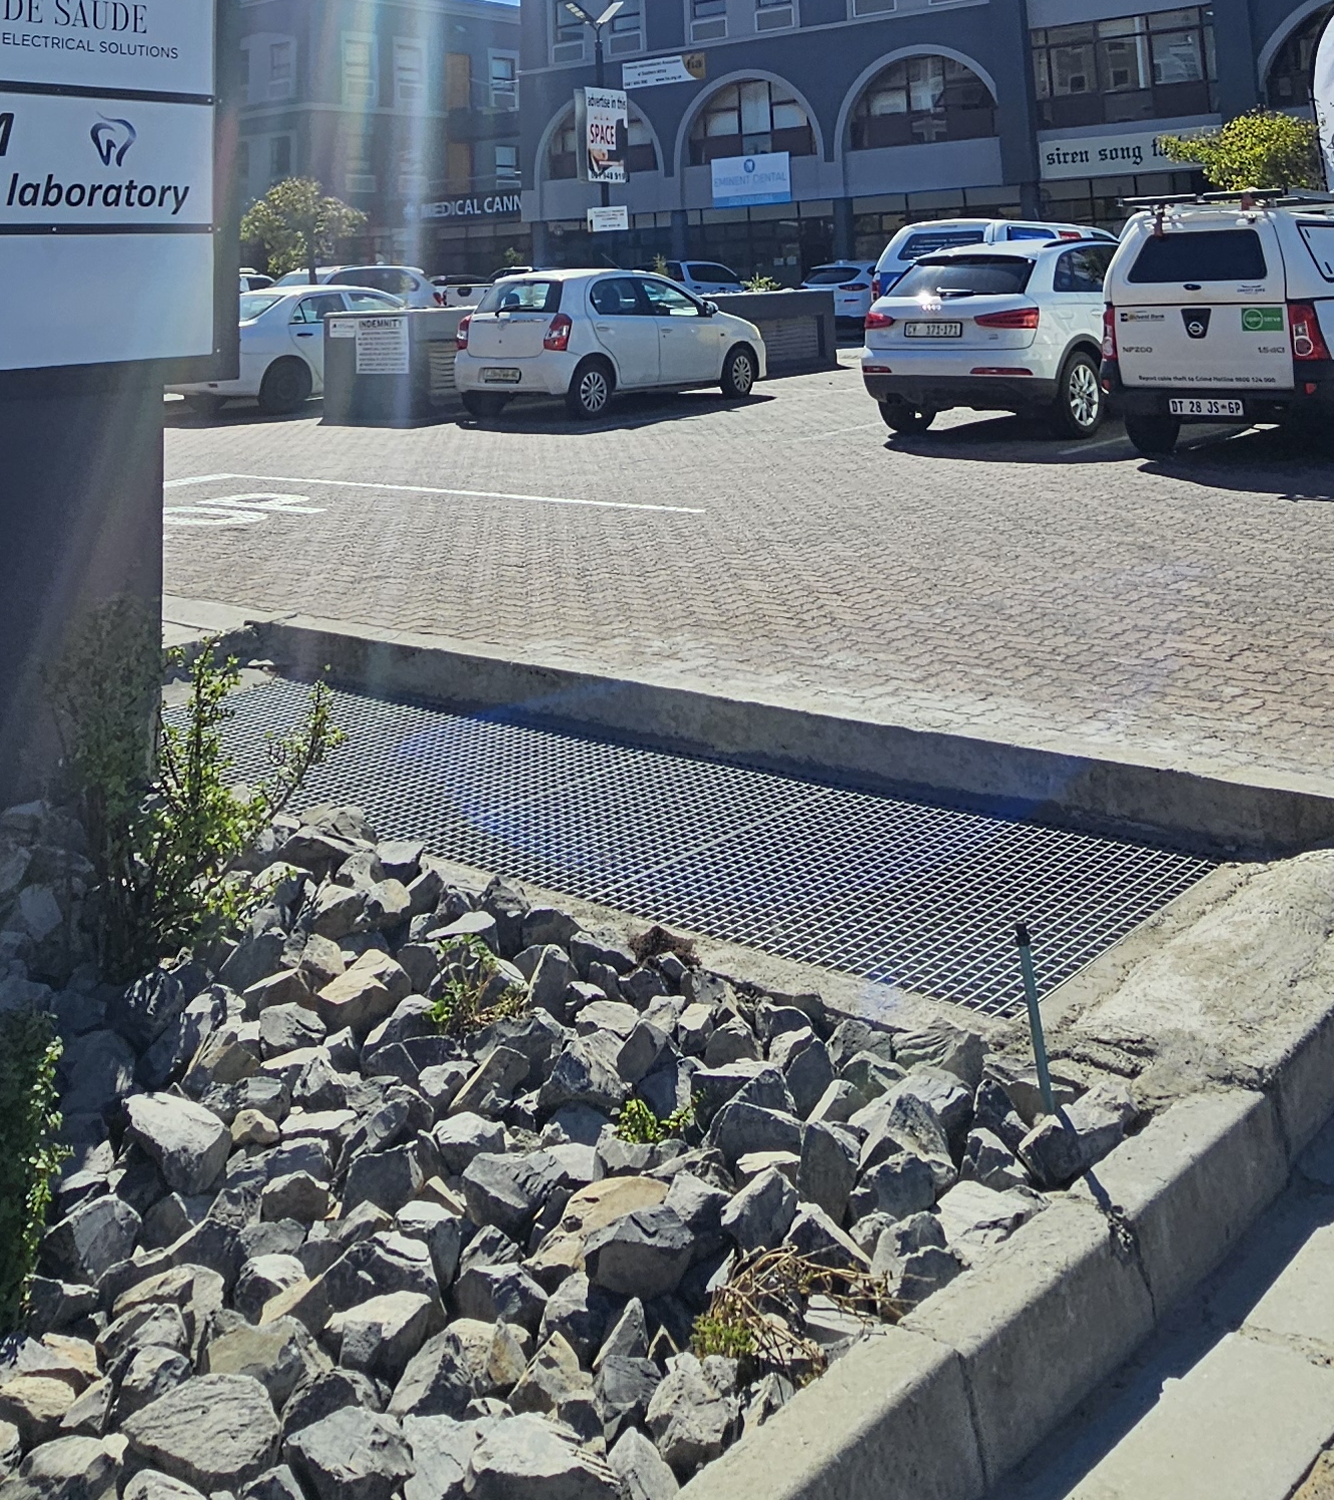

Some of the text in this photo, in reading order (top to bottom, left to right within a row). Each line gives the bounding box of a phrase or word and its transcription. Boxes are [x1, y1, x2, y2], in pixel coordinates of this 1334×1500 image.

[2, 32, 179, 60] ELECTRICAL SOLUTIONS
[590, 123, 615, 144] SPACE
[1046, 147, 1090, 166] siren
[1098, 146, 1143, 165] song
[714, 171, 787, 187] EMINENT DENTAL
[6, 173, 190, 215] laboratory
[421, 199, 482, 219] MEDICAL
[359, 319, 402, 329] INDEMNITY
[1171, 401, 1184, 413] DT
[1189, 401, 1202, 413] 28
